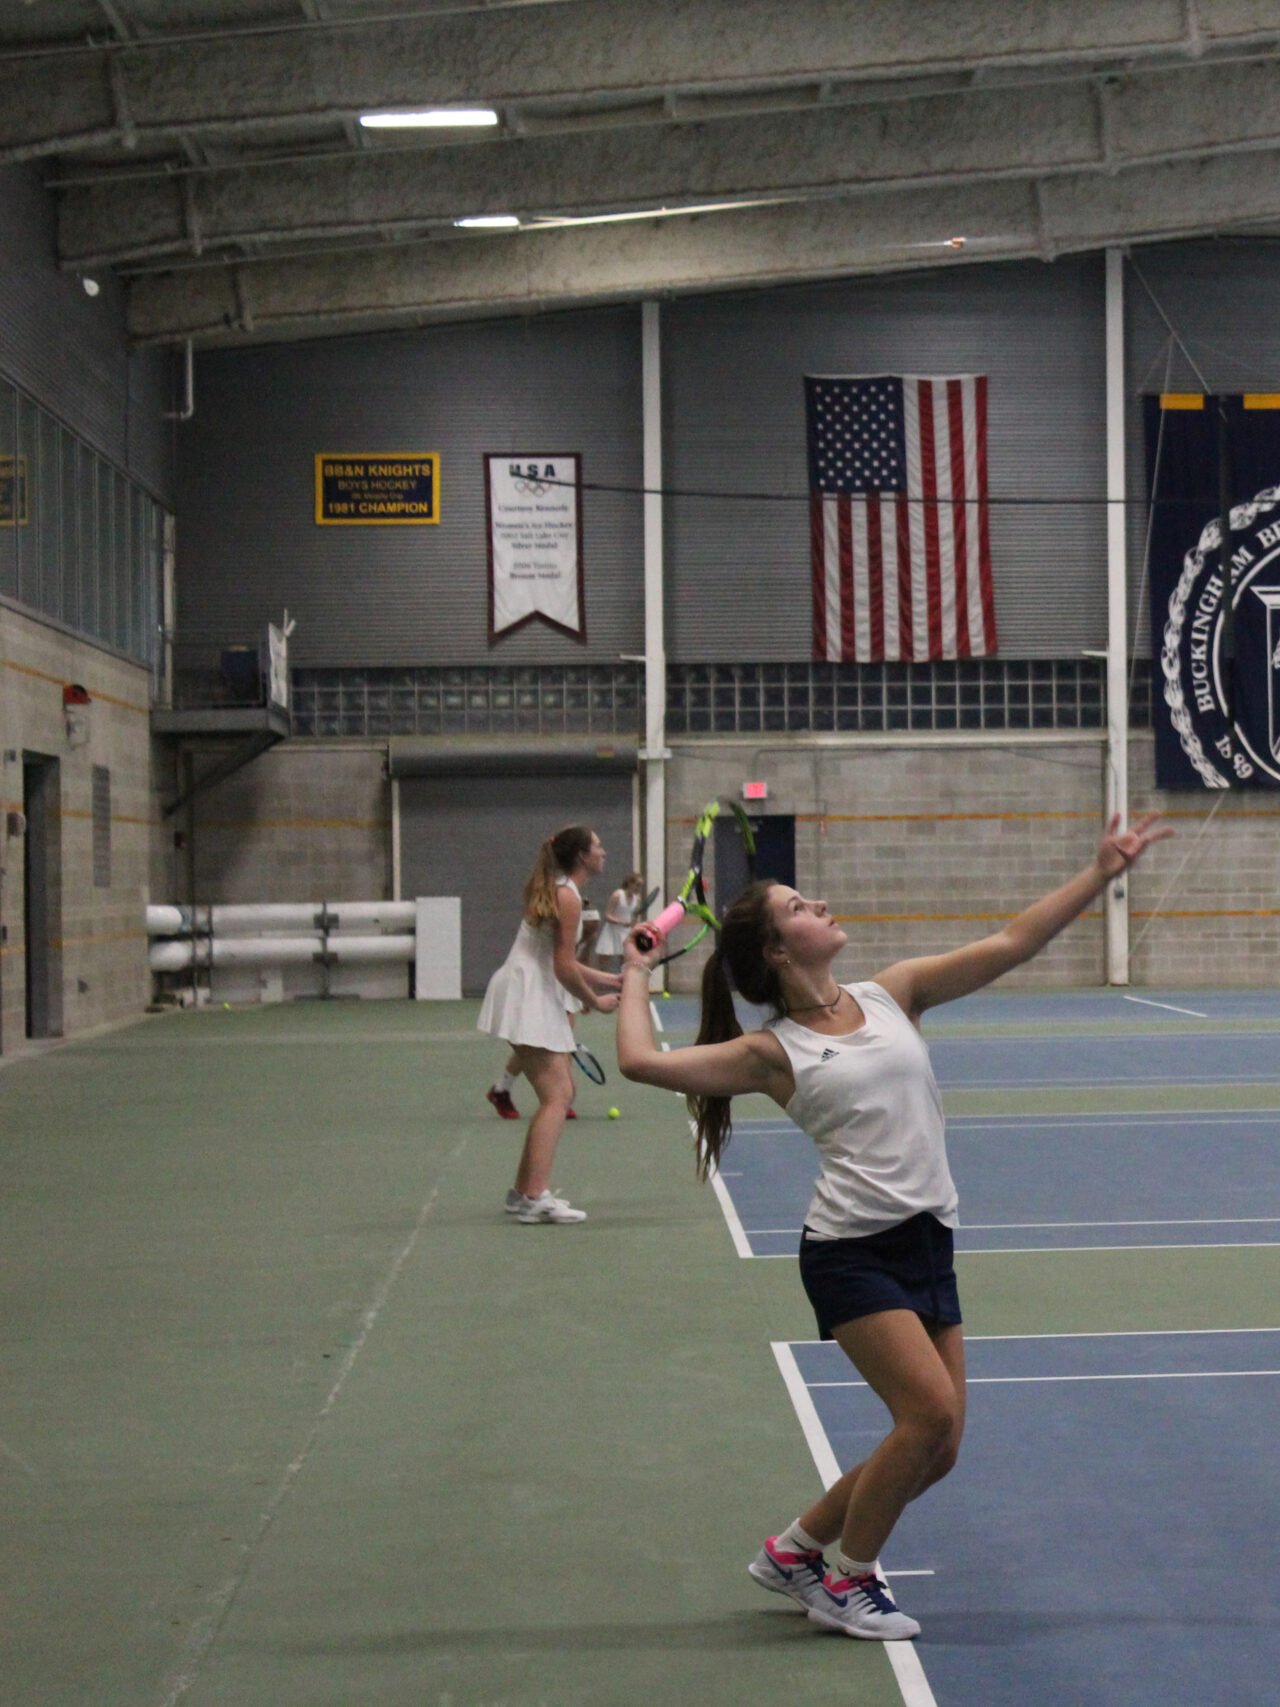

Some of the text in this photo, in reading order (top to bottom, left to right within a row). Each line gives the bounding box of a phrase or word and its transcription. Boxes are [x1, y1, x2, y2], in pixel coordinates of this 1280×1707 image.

[368, 464, 431, 476] KNIGHTS
[371, 480, 417, 490] HOCKEY
[358, 502, 428, 513] CHAMPION
